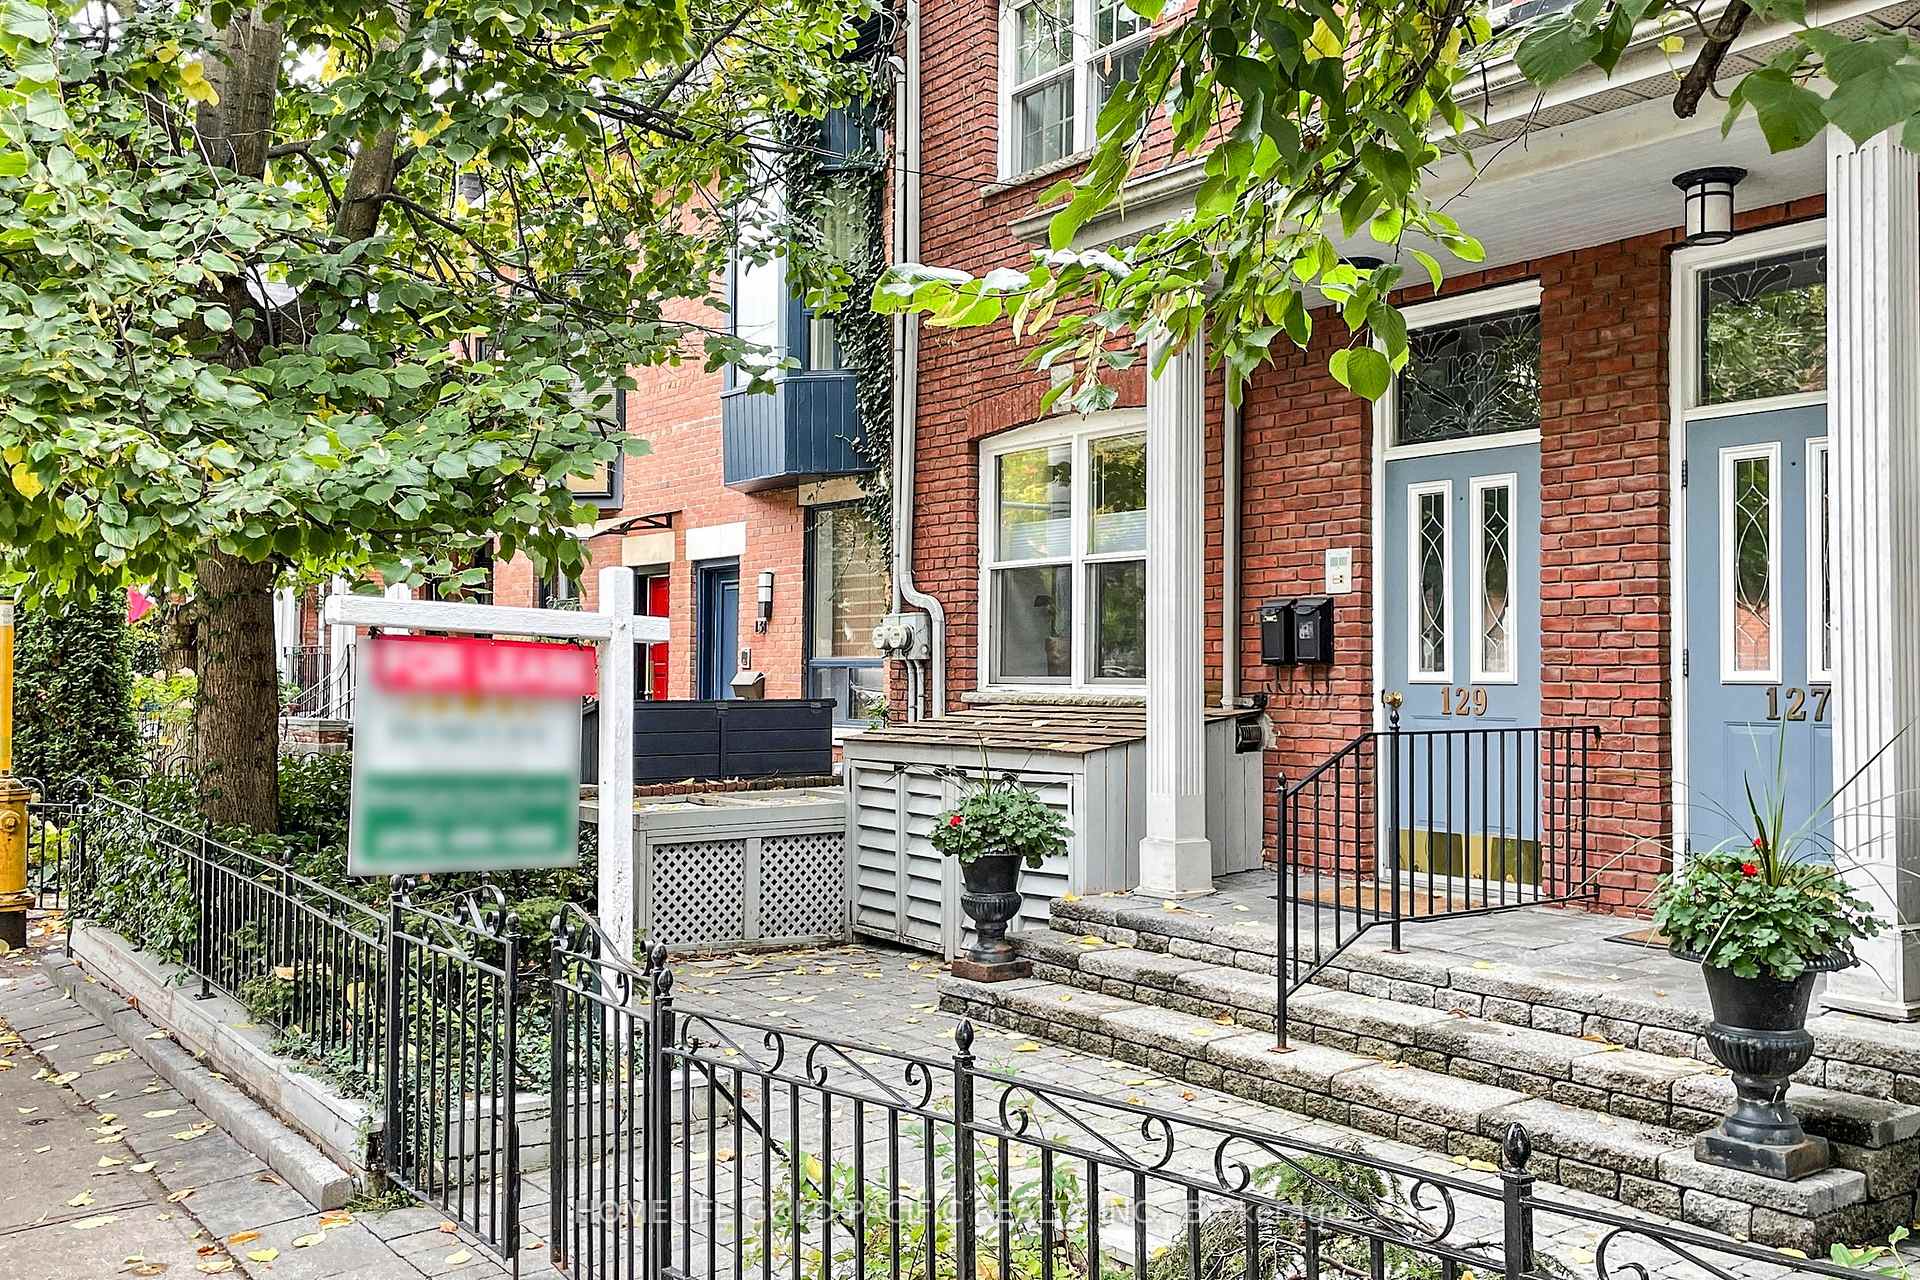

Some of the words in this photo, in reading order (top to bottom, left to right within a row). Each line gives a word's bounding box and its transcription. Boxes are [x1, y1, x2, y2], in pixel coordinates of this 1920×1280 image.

[1446, 349, 1499, 387] 129
[1441, 686, 1488, 716] 129
[1766, 686, 1831, 721] 127
